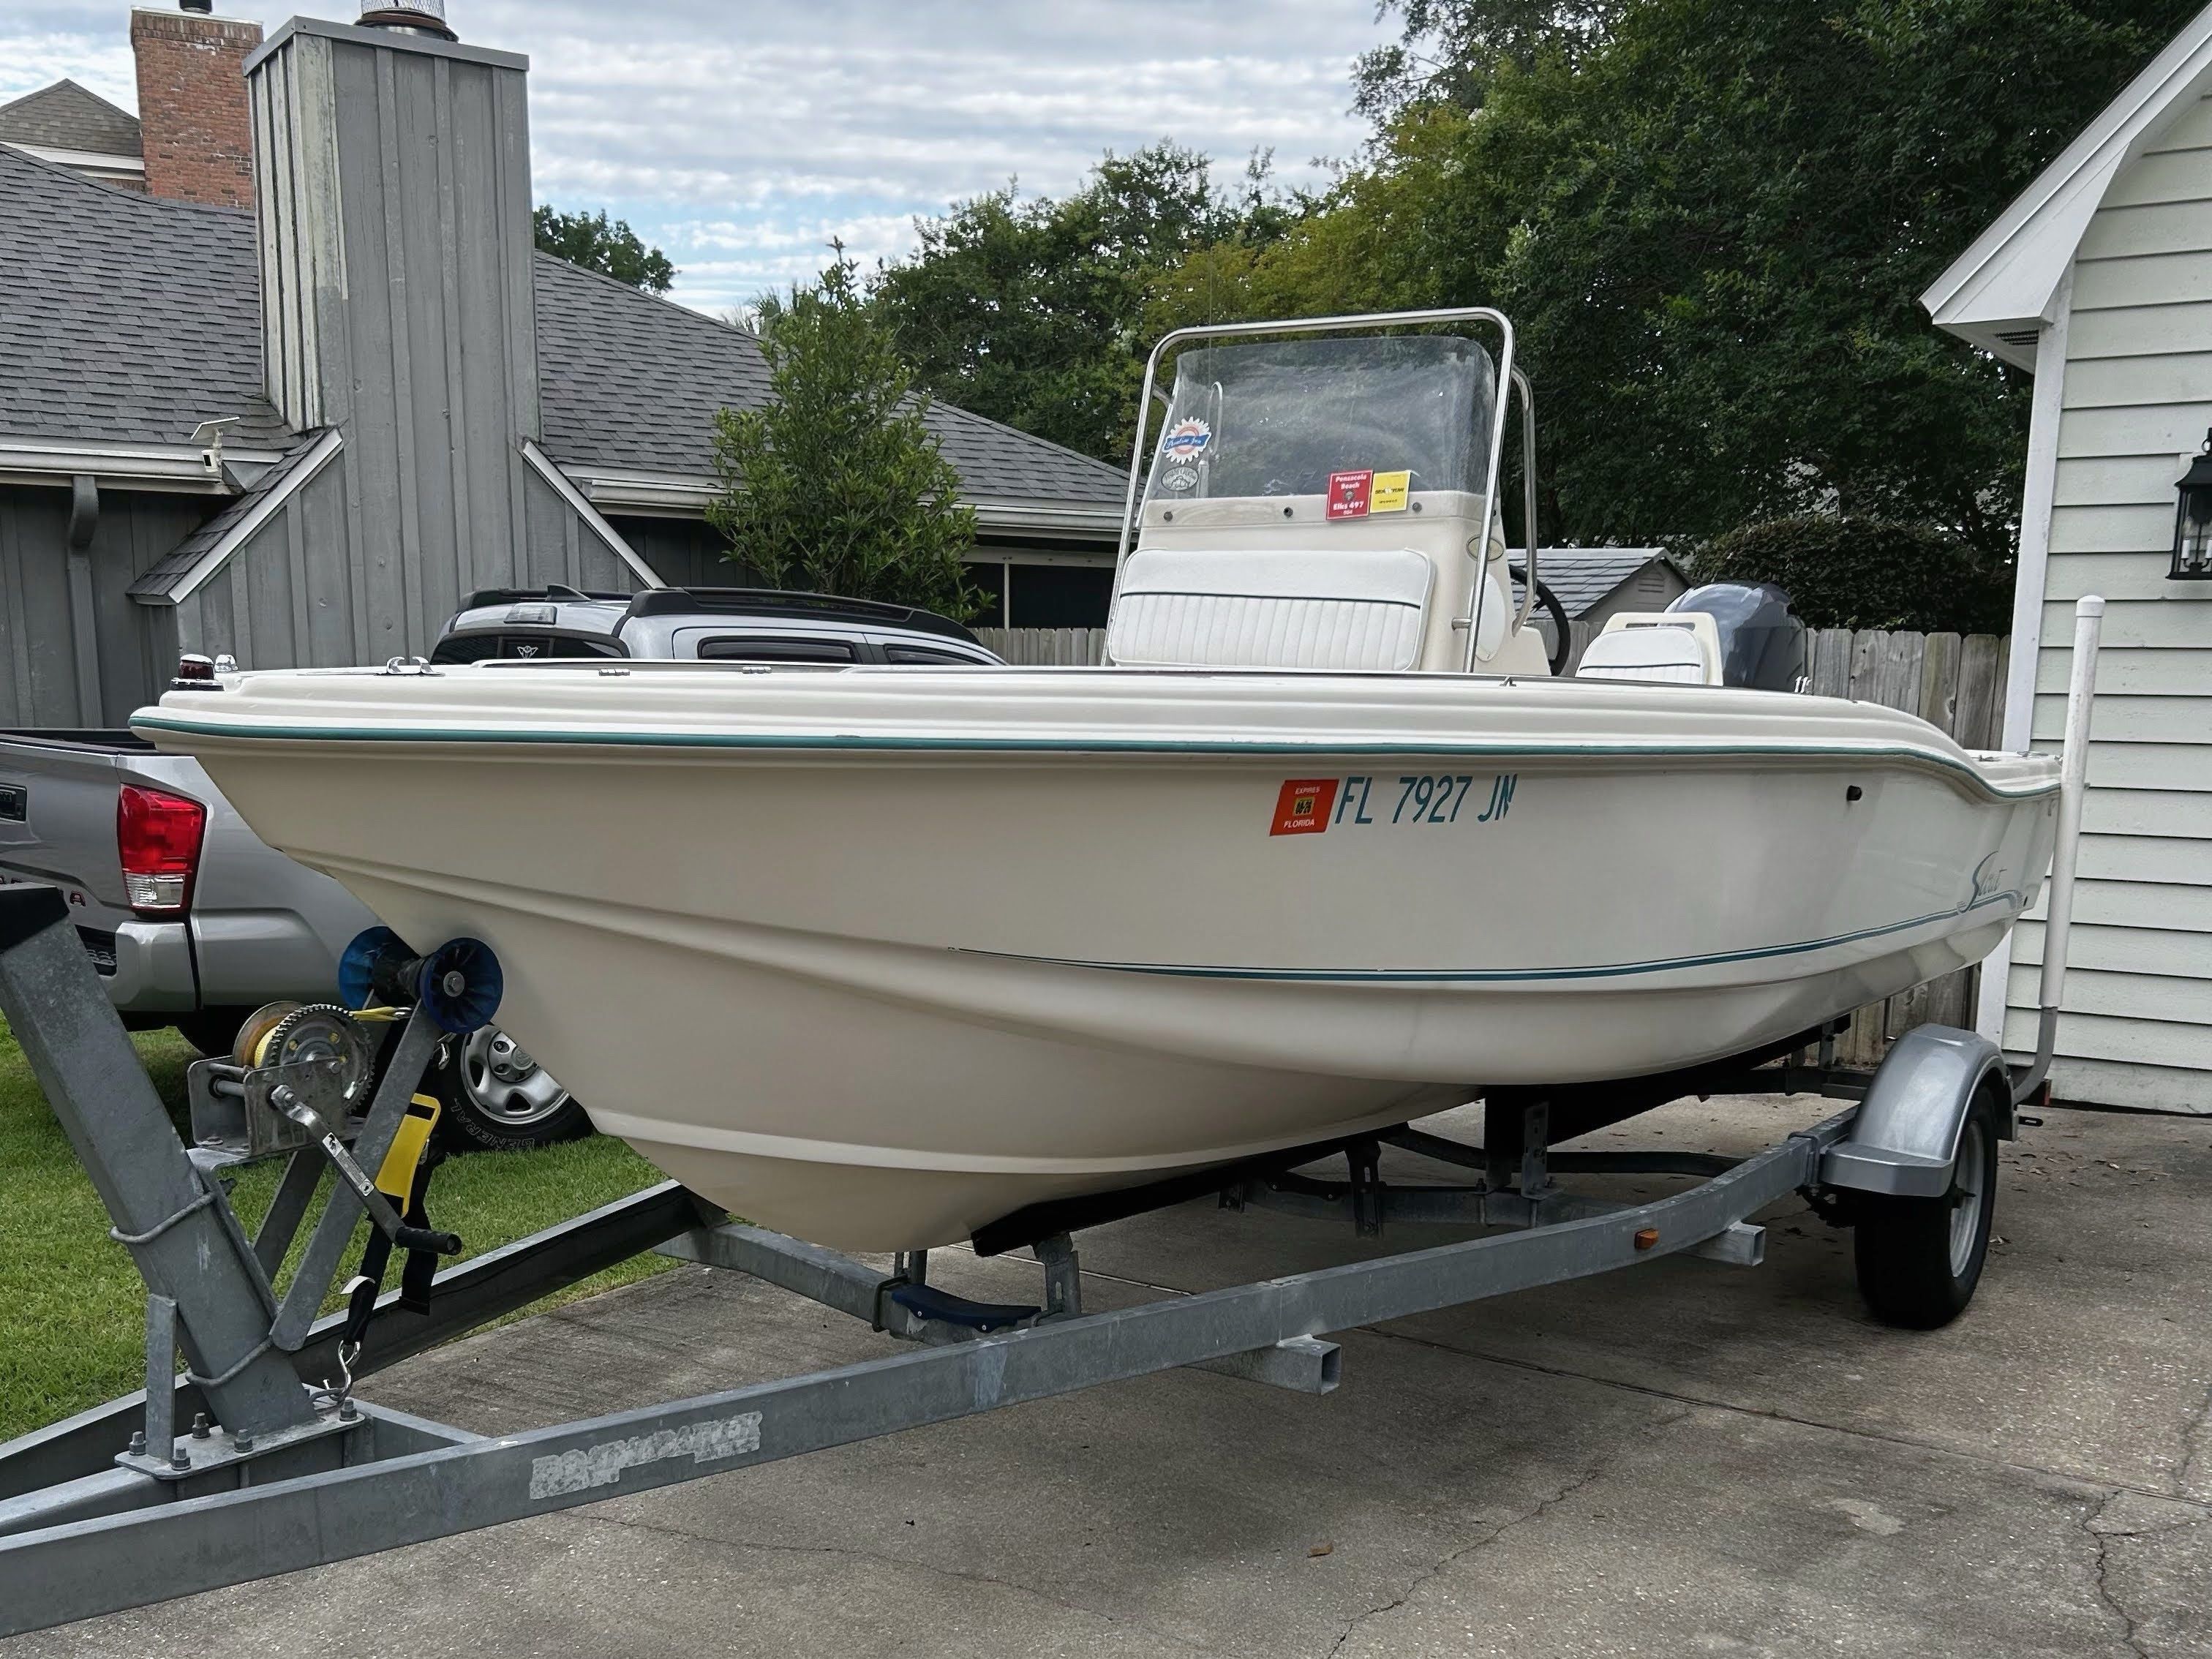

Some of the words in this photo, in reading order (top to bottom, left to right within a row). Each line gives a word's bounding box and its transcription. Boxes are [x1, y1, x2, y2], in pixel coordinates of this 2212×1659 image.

[1336, 474, 1367, 482] Pensacola
[1333, 503, 1348, 511] Elks
[1349, 500, 1364, 509] 497
[1295, 786, 1320, 795] EXPIRES
[1335, 777, 1373, 824] FL
[1393, 775, 1473, 824] 7927
[1477, 773, 1518, 823] JN
[1283, 819, 1315, 829] FLORIDA
[450, 1097, 535, 1150] GENERAL
